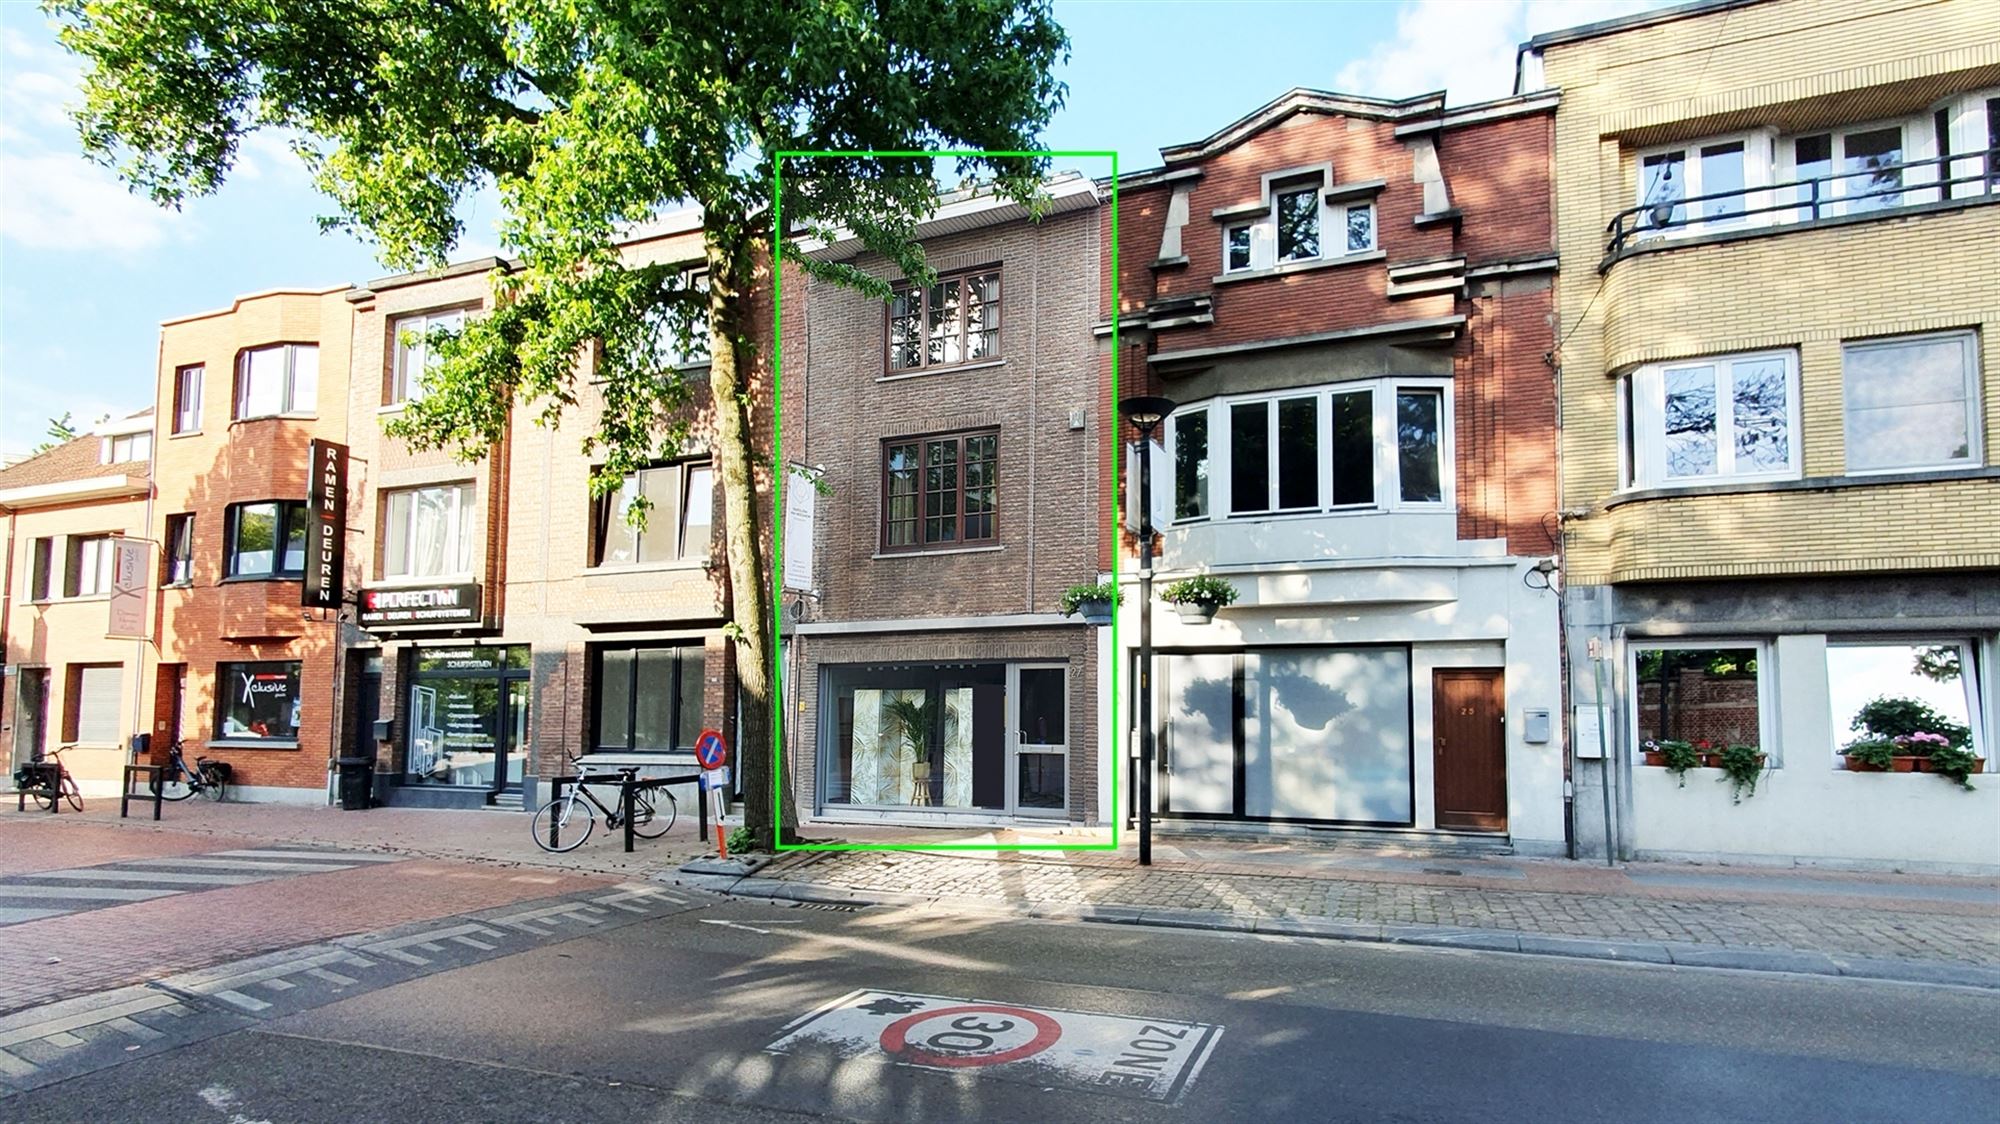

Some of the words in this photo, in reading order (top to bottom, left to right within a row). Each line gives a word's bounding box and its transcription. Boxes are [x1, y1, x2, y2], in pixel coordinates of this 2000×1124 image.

[324, 447, 337, 511] RAMEN
[319, 525, 334, 601] DEUREN
[1071, 664, 1082, 678] 27
[241, 672, 287, 708] Xclusive
[1461, 707, 1475, 716] 25
[926, 1015, 1015, 1051] 30
[1094, 1024, 1190, 1091] ZONE
